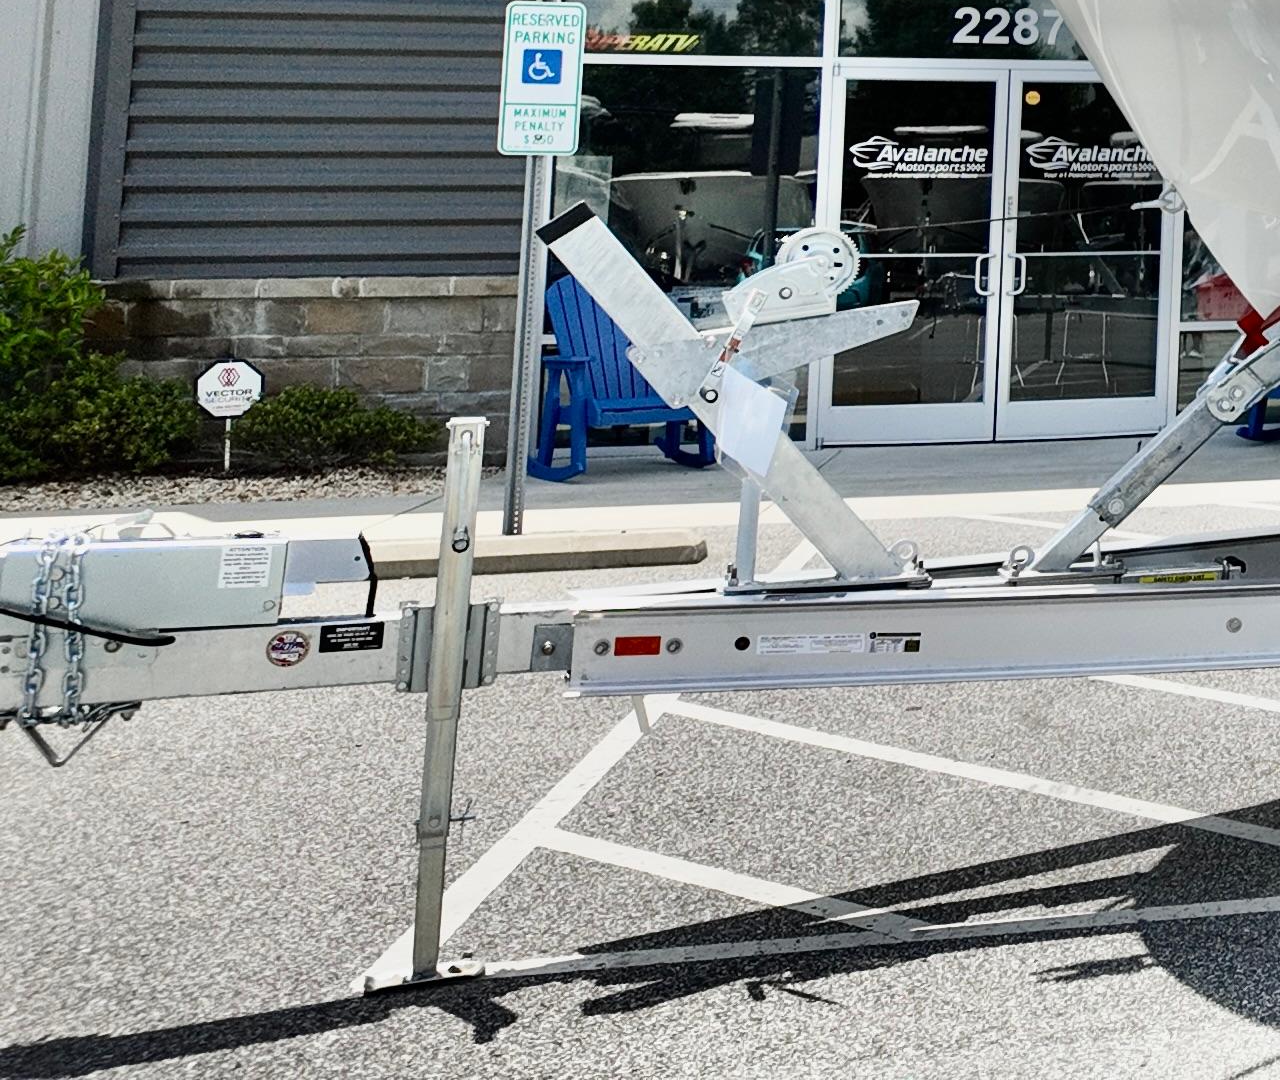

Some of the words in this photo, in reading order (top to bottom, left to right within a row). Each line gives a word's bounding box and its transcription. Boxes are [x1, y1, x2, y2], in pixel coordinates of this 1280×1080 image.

[512, 13, 580, 27] RESERVED
[952, 6, 1064, 45] 2287
[515, 30, 575, 44] PARKING
[514, 108, 567, 117] MAXIMUM
[514, 121, 565, 131] PENALTY
[876, 145, 989, 162] Avalanche
[895, 162, 966, 172] Motorsports
[1070, 162, 1138, 172] Motorsports
[205, 389, 252, 397] VECTOR
